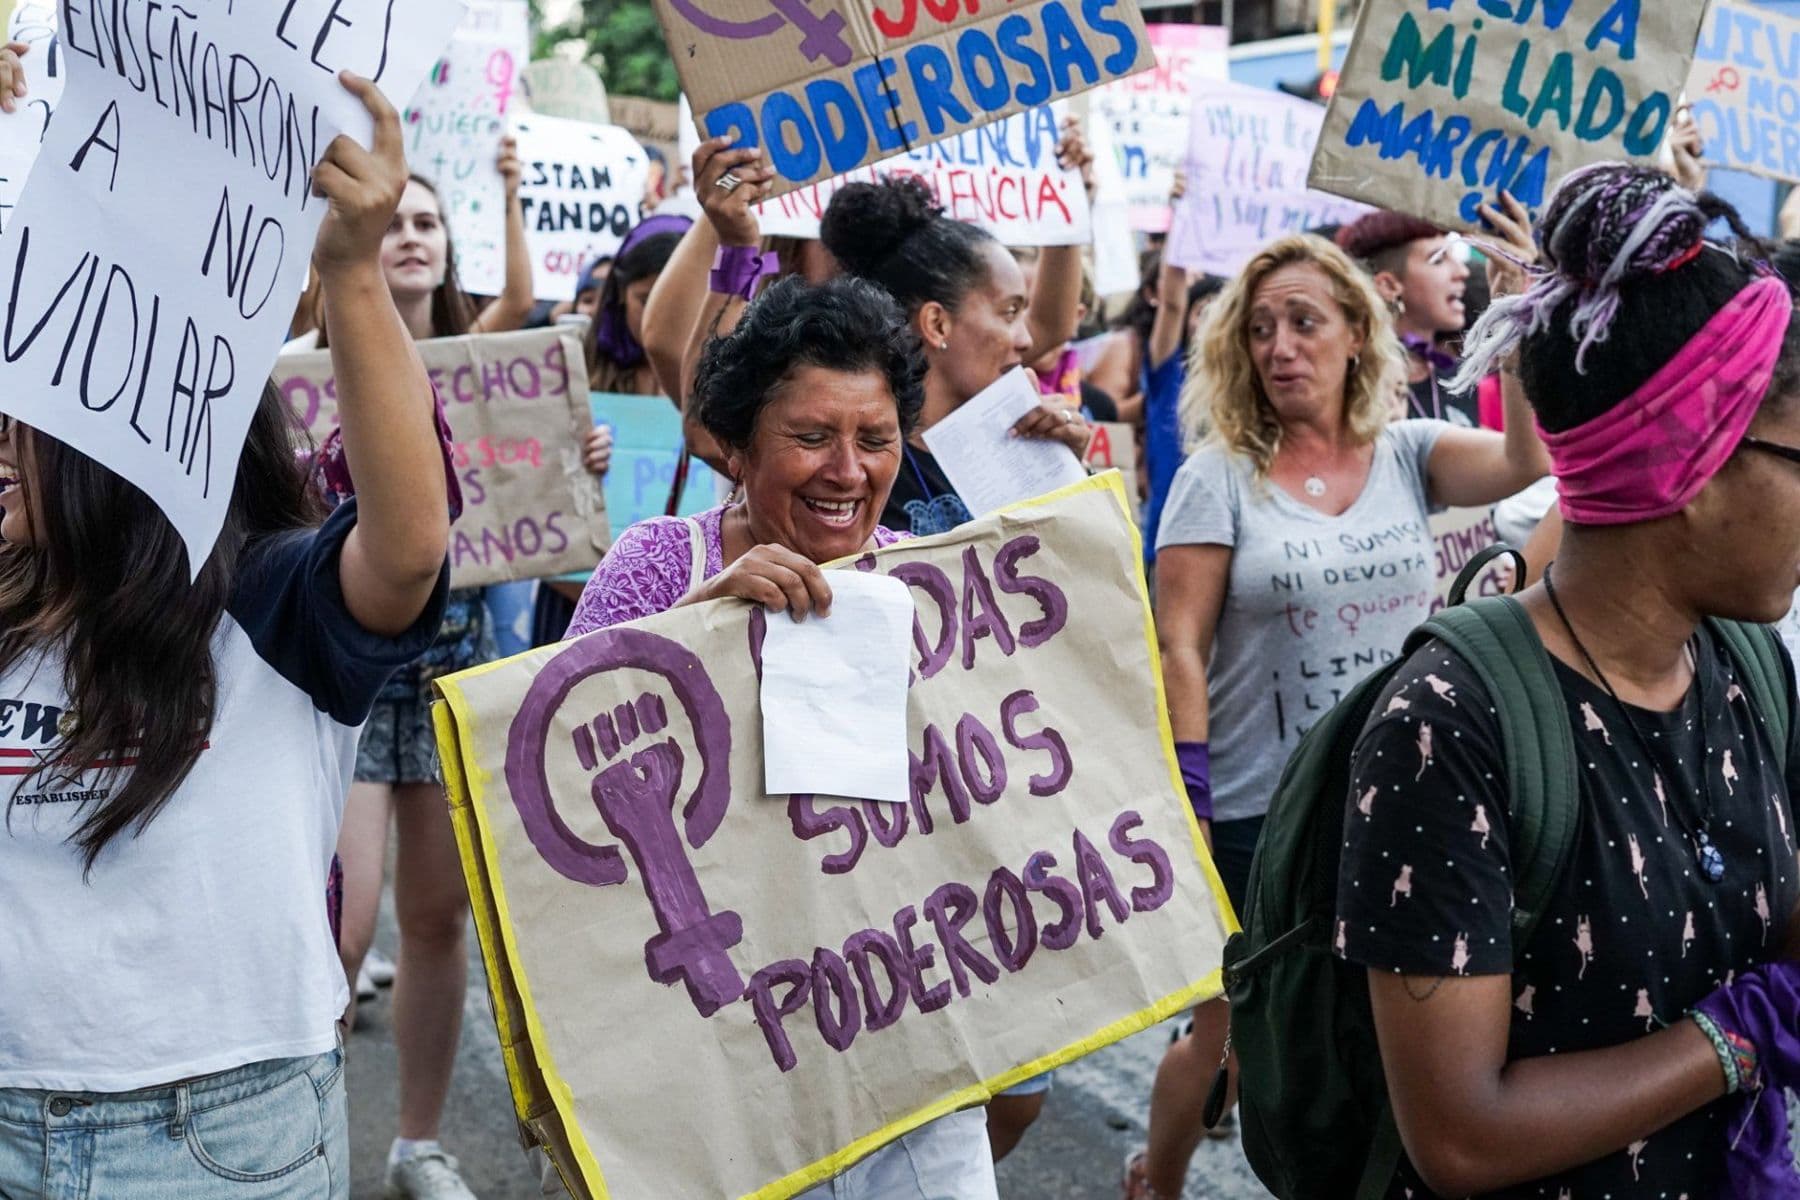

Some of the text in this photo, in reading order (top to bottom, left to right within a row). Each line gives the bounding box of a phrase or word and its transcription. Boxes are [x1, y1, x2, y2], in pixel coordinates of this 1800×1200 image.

[64, 0, 319, 211] ENSEÑARON
[69, 100, 120, 191] A
[704, 0, 1138, 182] PODEROSAS
[1502, 38, 1671, 157] LADO
[521, 161, 612, 190] STAN
[1345, 99, 1550, 207] MARCHA
[202, 185, 284, 319] NO
[4, 226, 234, 499] VIOLAR
[855, 535, 1068, 680] DAS
[1271, 552, 1427, 592] NI DEVOTA
[1284, 539, 1322, 561] NI
[1284, 602, 1319, 638] te
[16, 788, 110, 805] ESTABLISHED
[787, 689, 1073, 875] SOMOS
[744, 810, 1174, 1073] PODEROSAS
